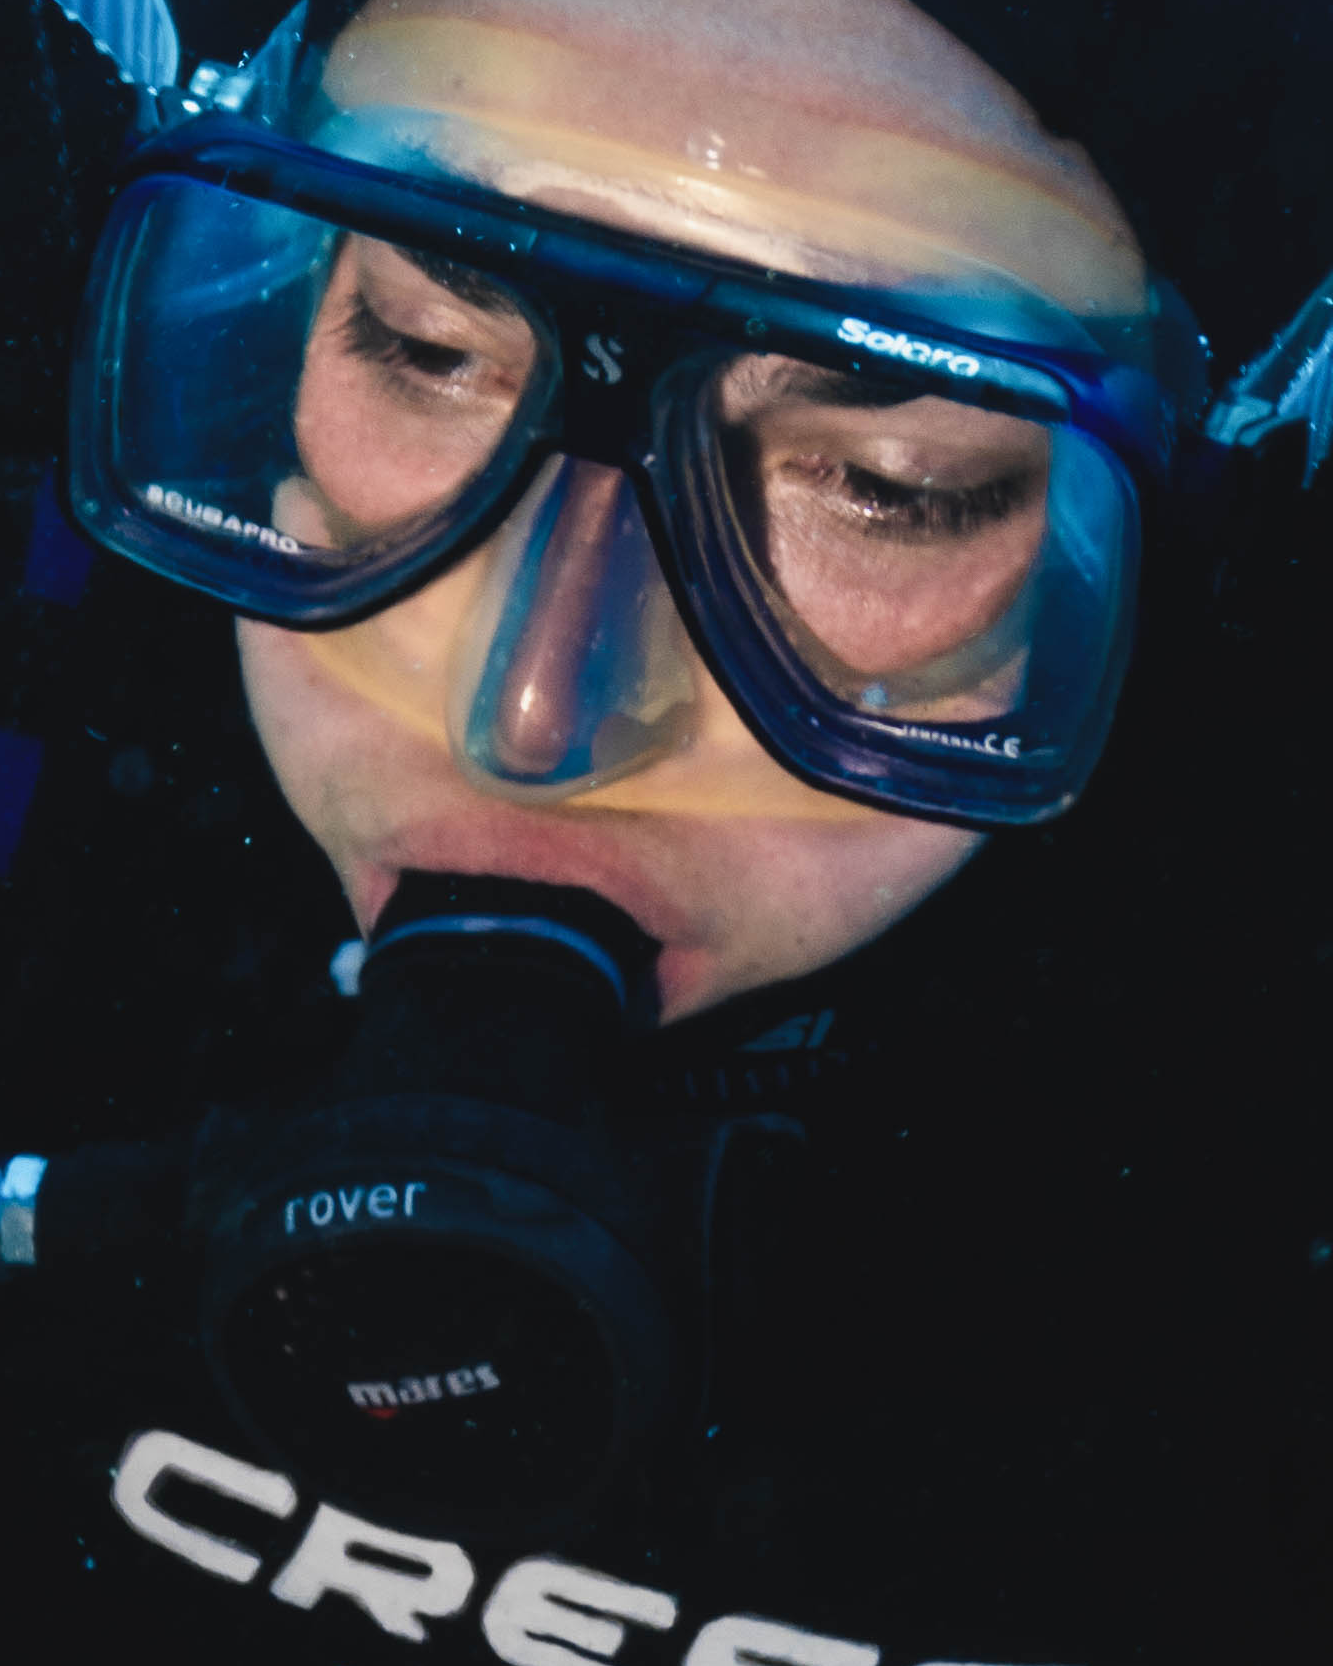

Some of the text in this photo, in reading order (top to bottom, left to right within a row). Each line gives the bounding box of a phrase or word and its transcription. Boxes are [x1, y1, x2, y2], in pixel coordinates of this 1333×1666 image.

[837, 318, 981, 378] Solara
[145, 484, 300, 554] SCUBAPRO
[286, 1182, 427, 1233] rover
[347, 1363, 500, 1407] mares
